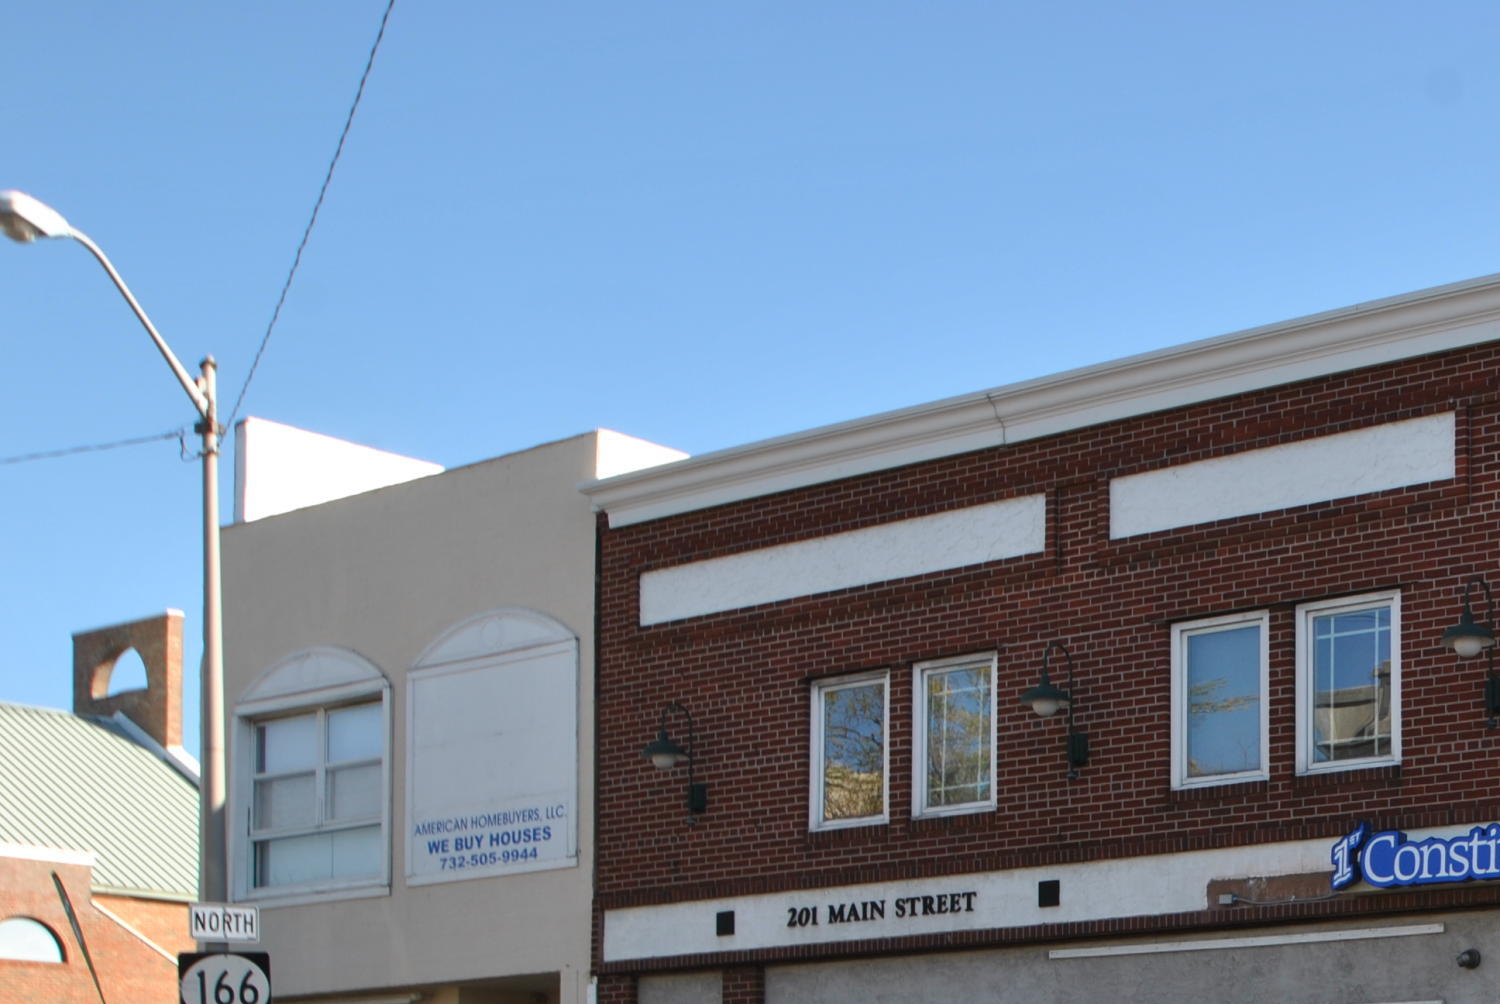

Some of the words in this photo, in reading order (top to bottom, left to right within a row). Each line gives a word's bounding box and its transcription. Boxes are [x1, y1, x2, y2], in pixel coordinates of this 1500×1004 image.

[414, 817, 468, 837] AMERICAN
[471, 807, 543, 830] HOMEBUYERS,
[428, 839, 449, 855] WE
[455, 834, 484, 852] BUY
[490, 826, 552, 848] HOUSES
[440, 847, 538, 871] 732-505-9944
[194, 910, 255, 934] NORTH
[786, 907, 819, 928] 201
[828, 900, 886, 924] MAIN
[895, 891, 977, 918] STREET
